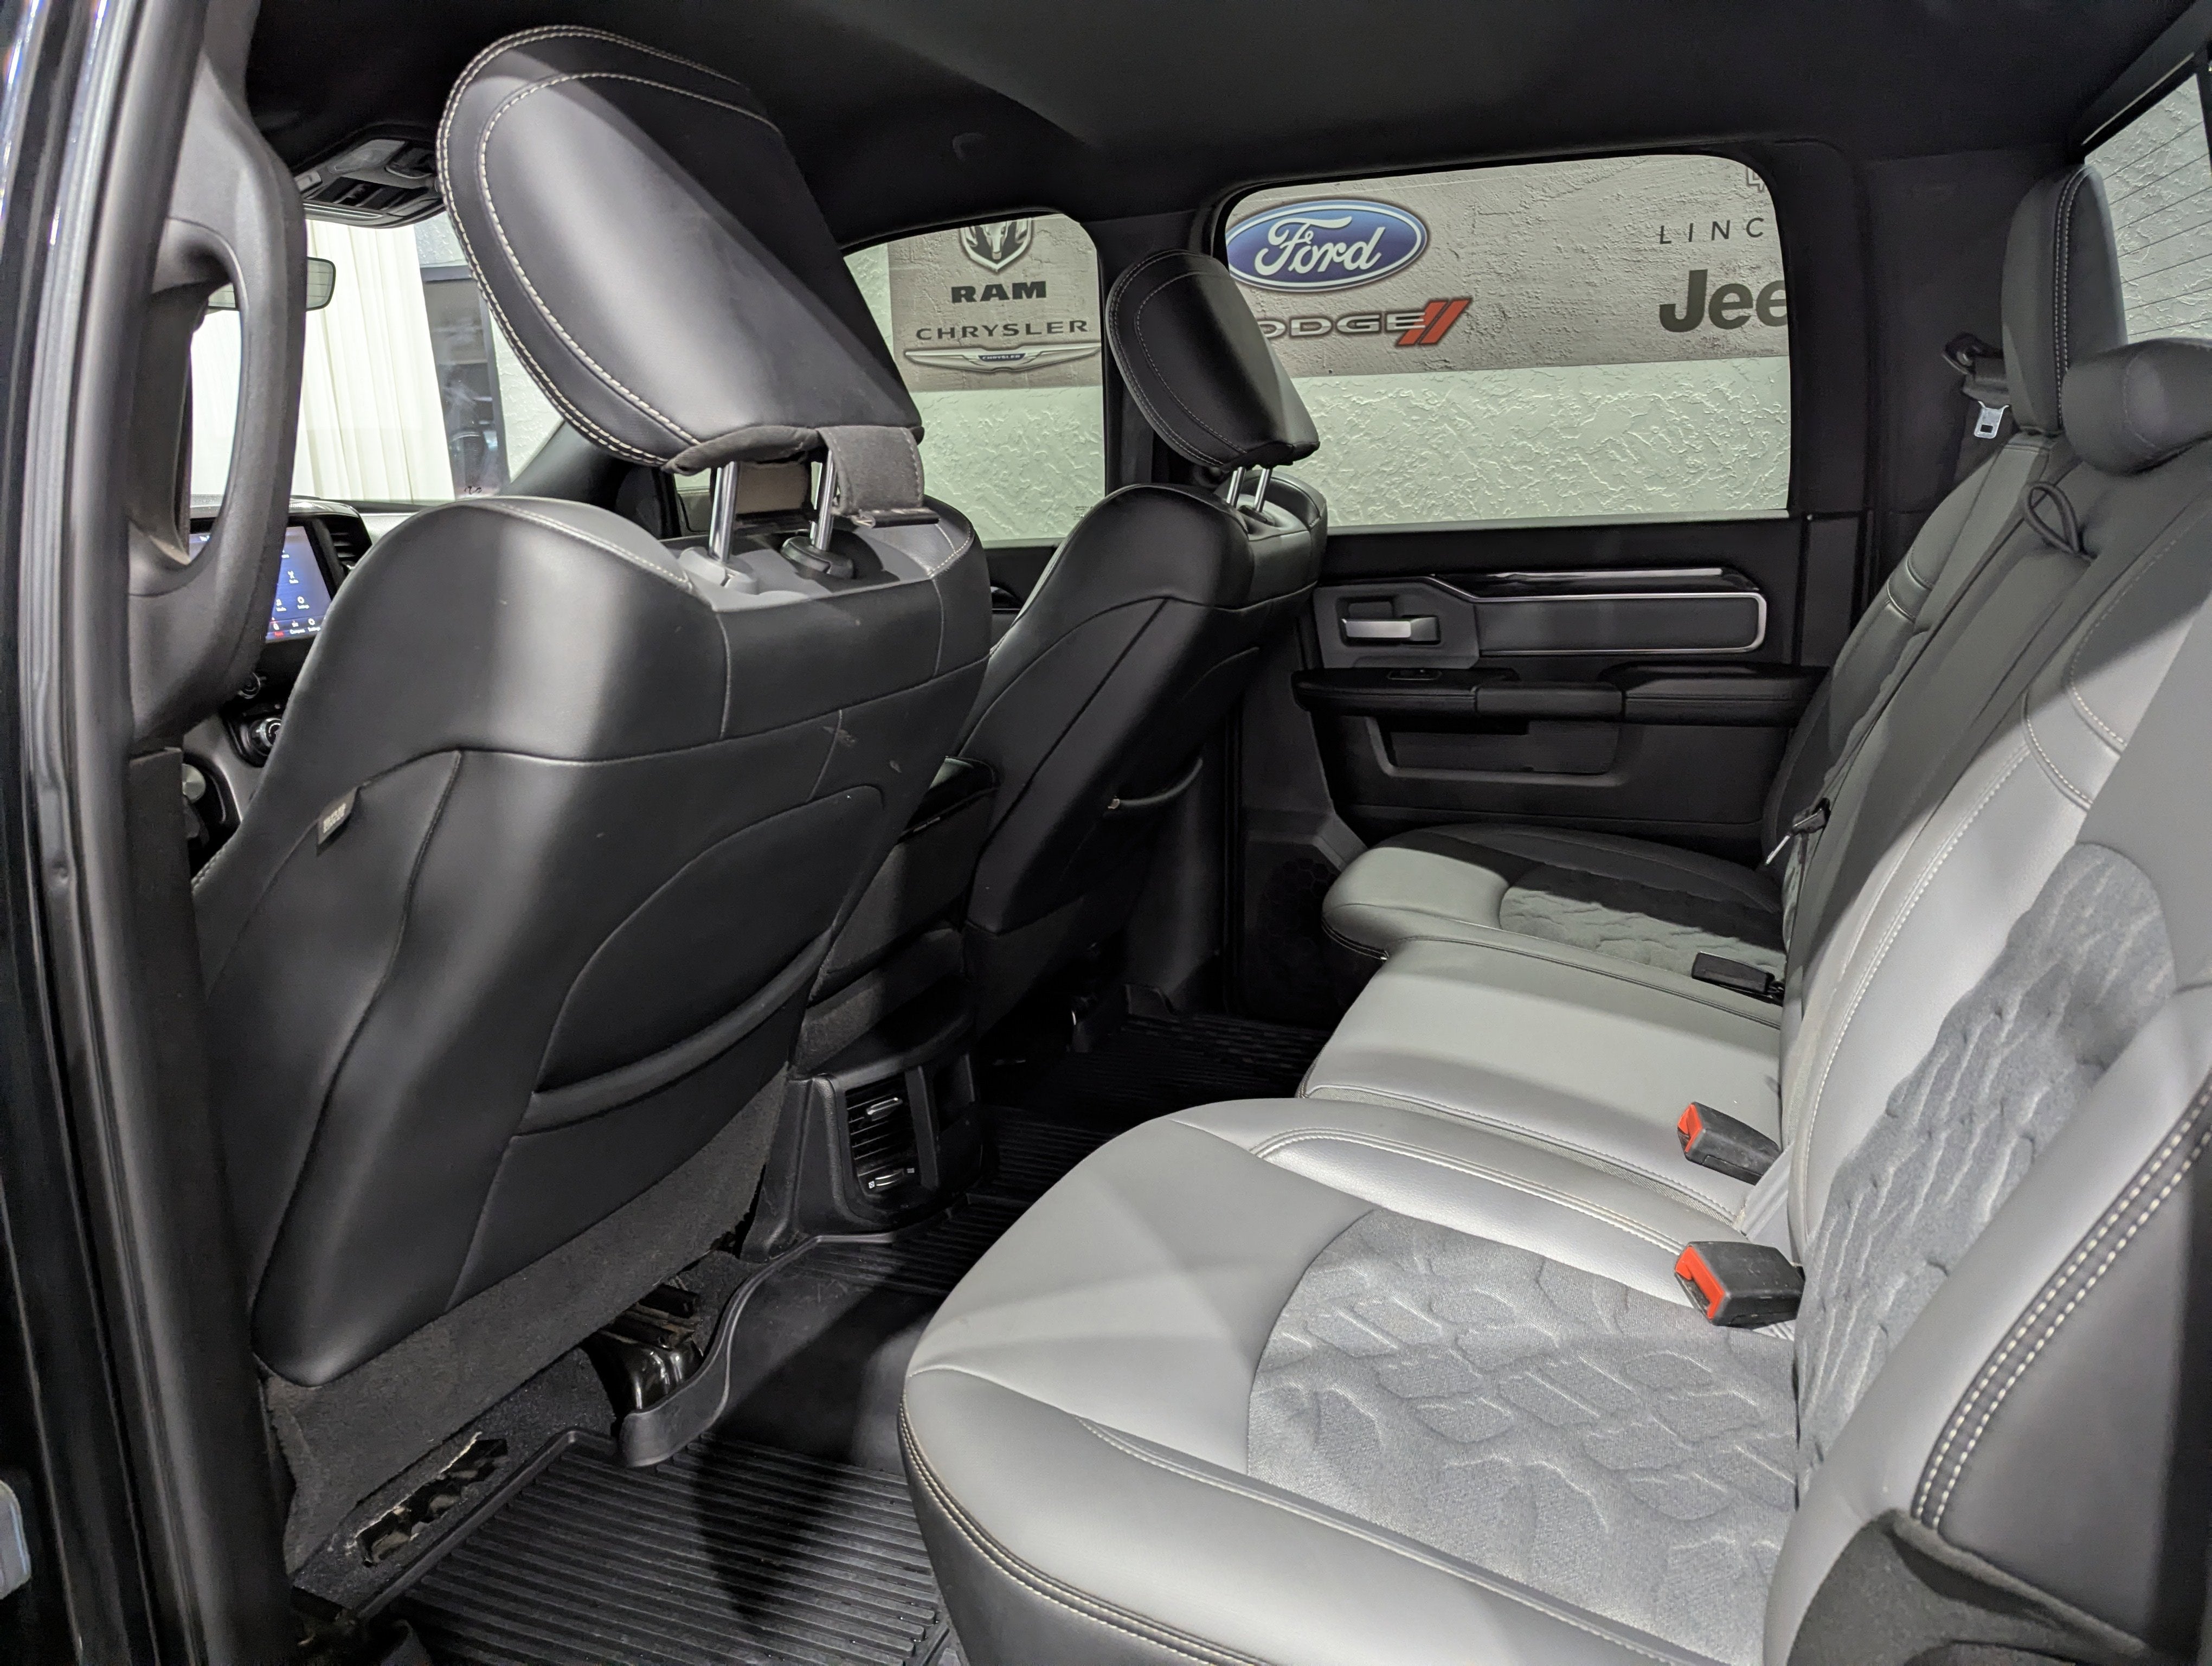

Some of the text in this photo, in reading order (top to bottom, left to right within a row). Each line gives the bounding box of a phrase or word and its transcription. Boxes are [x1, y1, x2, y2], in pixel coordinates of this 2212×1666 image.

[1255, 216, 1385, 275] Ford
[951, 281, 1046, 303] RAM
[916, 320, 1088, 341] CHRYSLER
